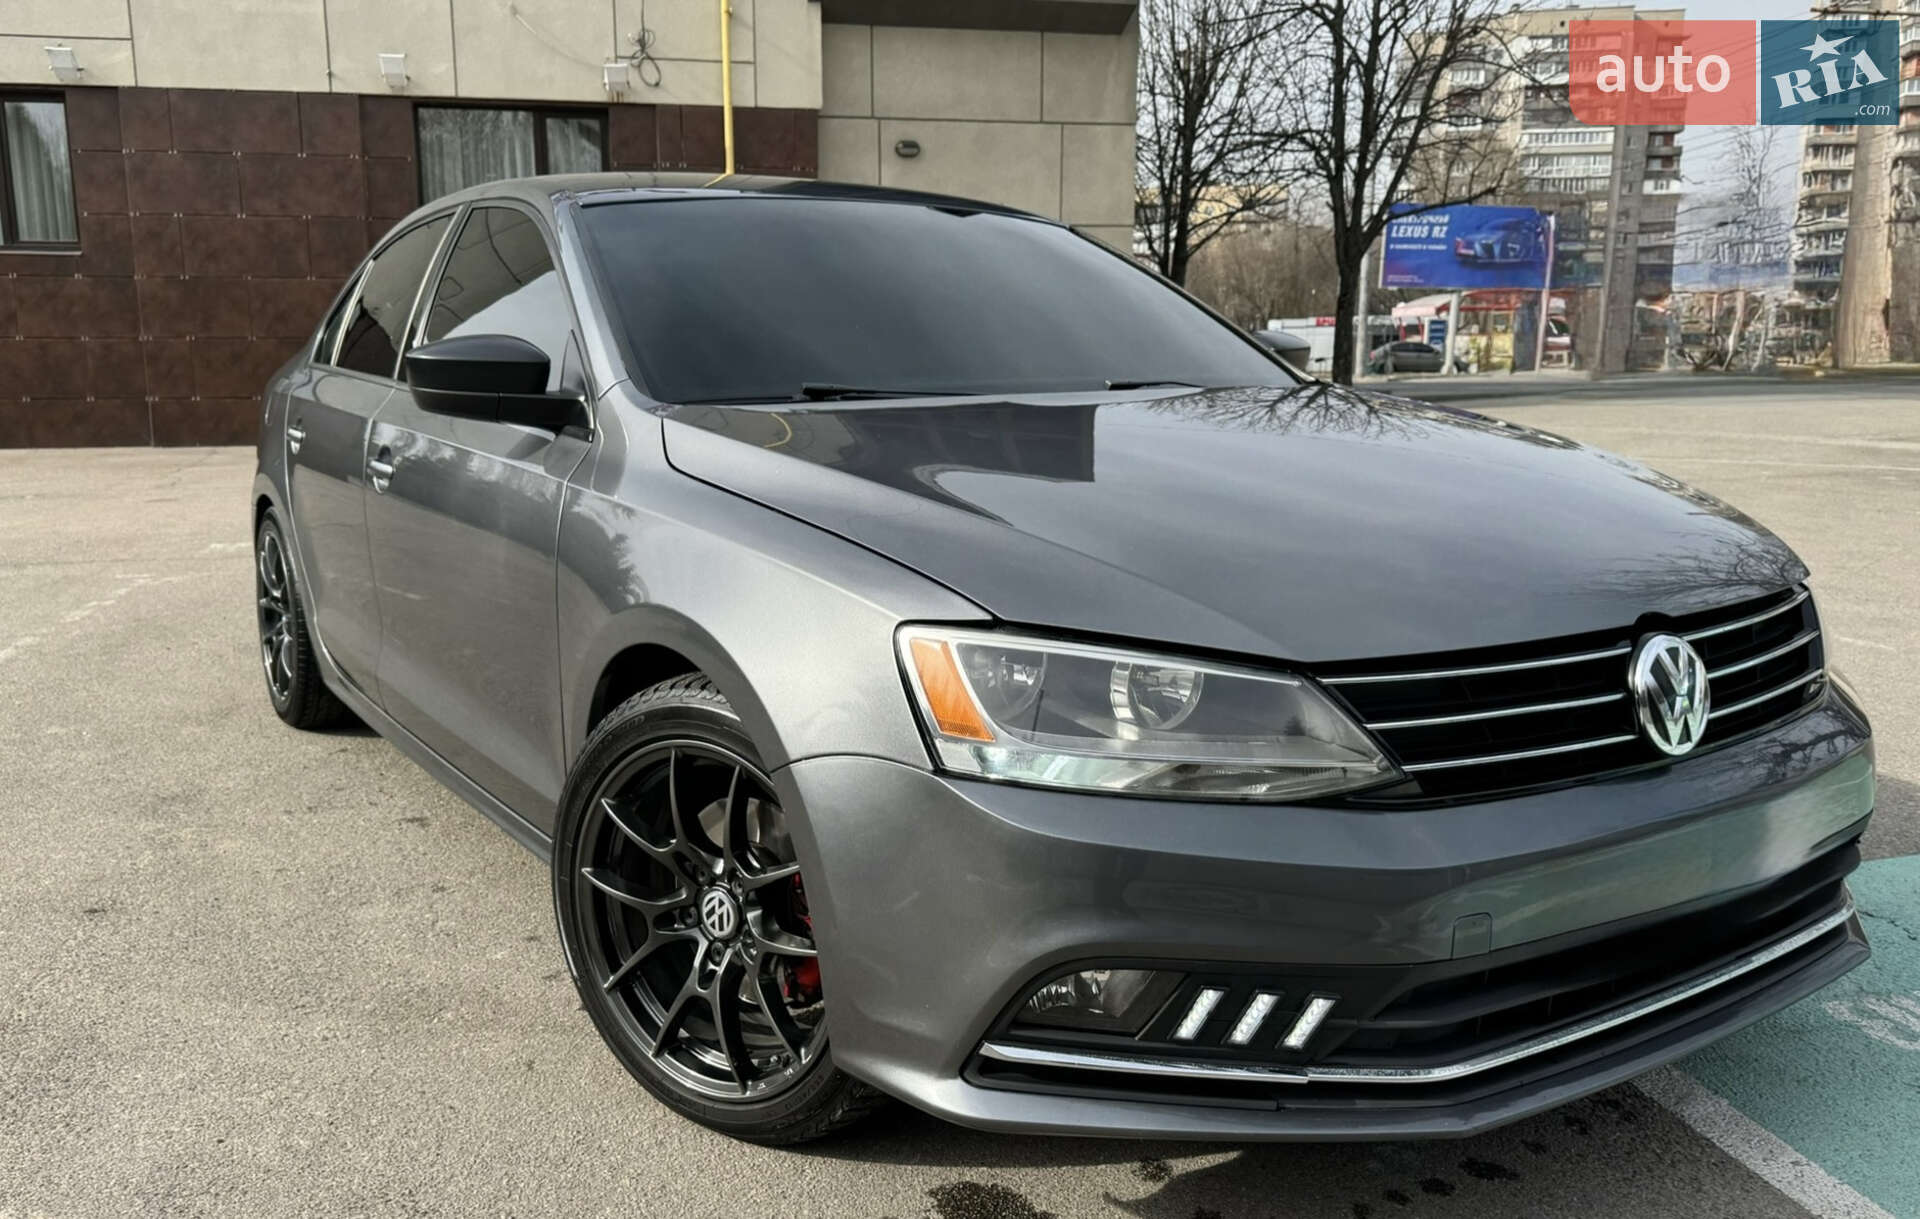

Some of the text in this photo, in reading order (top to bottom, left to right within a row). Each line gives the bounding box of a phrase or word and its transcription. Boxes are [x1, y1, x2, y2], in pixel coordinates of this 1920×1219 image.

[1391, 225, 1449, 238] LEXUS RZ
[1637, 635, 1706, 754] VW
